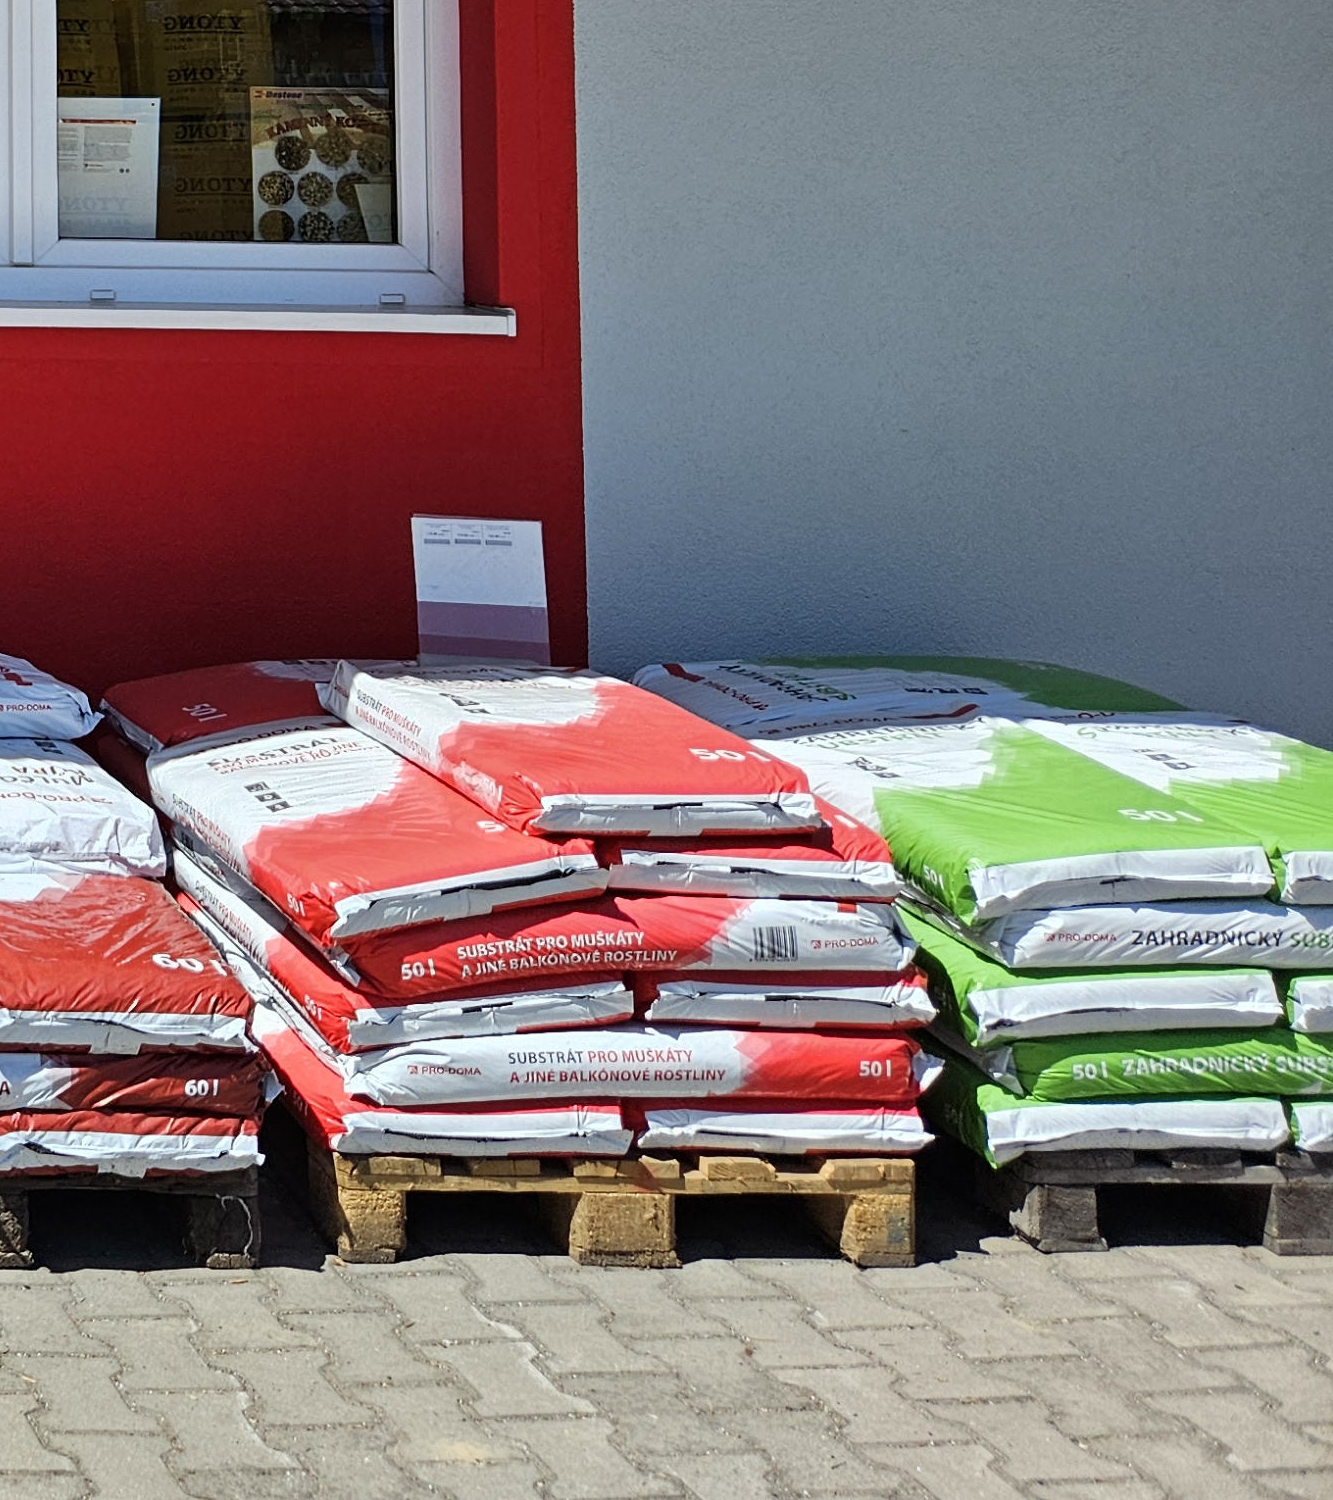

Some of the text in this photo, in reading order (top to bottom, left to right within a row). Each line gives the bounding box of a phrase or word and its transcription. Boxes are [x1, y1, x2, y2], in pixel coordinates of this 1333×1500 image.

[182, 703, 218, 717] 50
[689, 748, 745, 761] 50
[1118, 809, 1178, 822] 50
[923, 865, 938, 883] 50
[287, 893, 300, 913] 50
[457, 930, 645, 960] SUBSTRÁT PRO MUŠKÁTY
[824, 936, 879, 948] PRO-DOMA
[1058, 928, 1333, 949] PRO-DOMA ZAHRADNICKÝ SUB
[151, 953, 206, 974] 60
[401, 961, 425, 980] 50
[461, 950, 677, 978] A JINÉ BALKÓNOVÉ ROSTLINY
[421, 1047, 693, 1076] PRO-DOMA SUBSTRÁT PRO MUŠKÁTY
[859, 1060, 882, 1077] 50
[1072, 1063, 1097, 1081] 50
[1122, 1053, 1269, 1077] ZAHRADNICKÝ
[1276, 1056, 1333, 1073] SUBS
[509, 1067, 726, 1083] A JINÉ BALKÓNOVÉ ROSTLINY
[185, 1079, 209, 1096] 60
